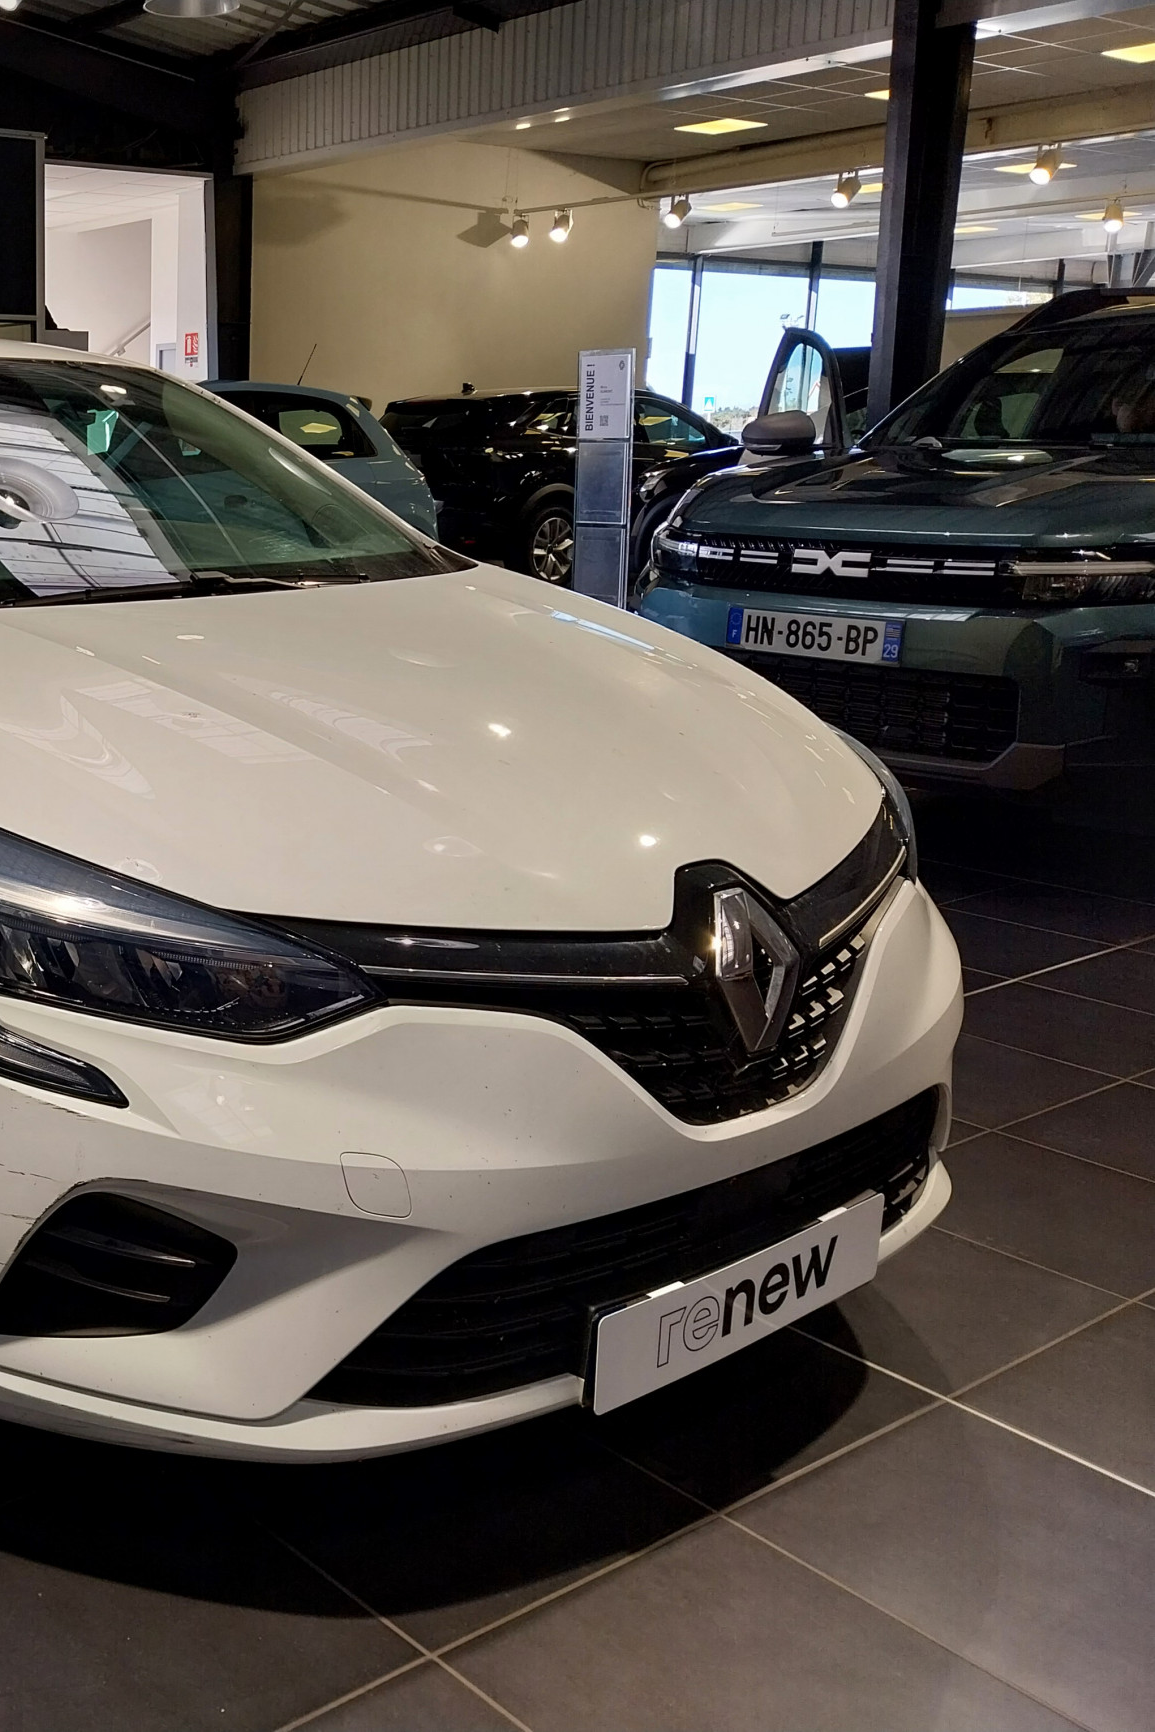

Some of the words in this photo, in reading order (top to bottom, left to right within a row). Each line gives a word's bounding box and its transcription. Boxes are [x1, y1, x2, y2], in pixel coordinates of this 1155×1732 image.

[585, 370, 595, 431] BIENVENUE
[731, 629, 738, 639] F
[745, 614, 879, 656] HN-865-BP
[883, 643, 899, 659] 29
[656, 1234, 839, 1369] renew
